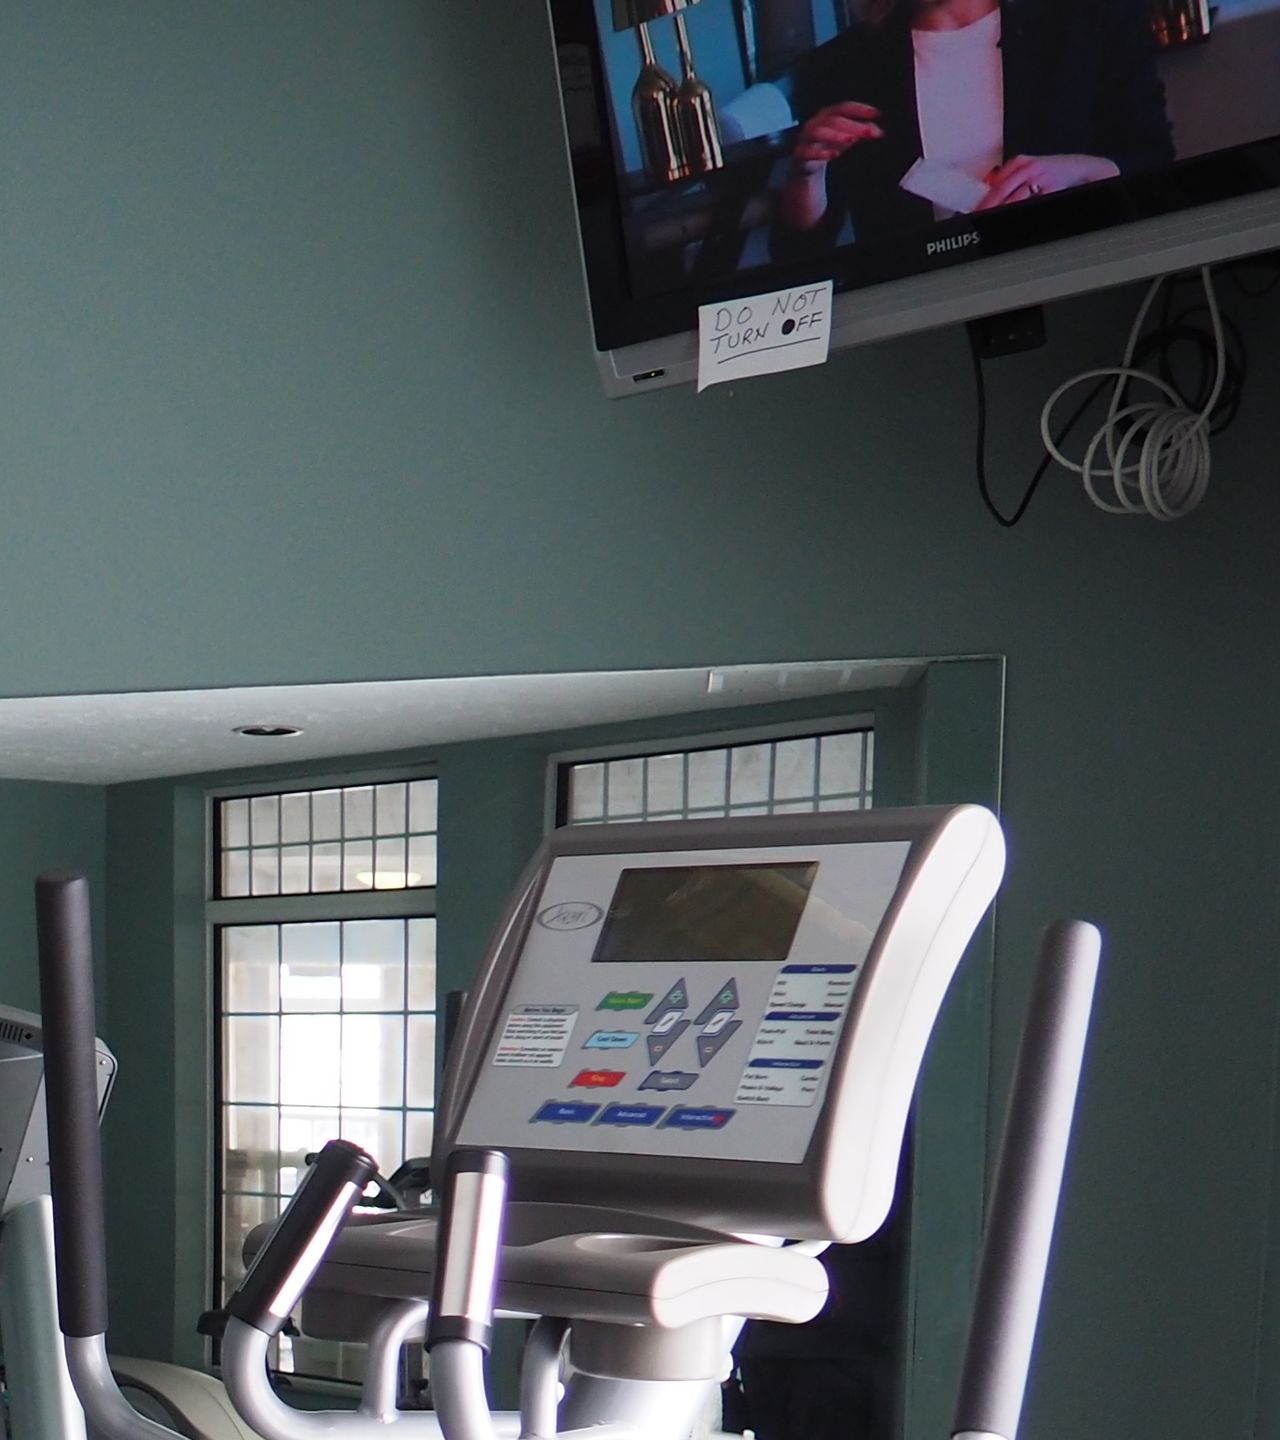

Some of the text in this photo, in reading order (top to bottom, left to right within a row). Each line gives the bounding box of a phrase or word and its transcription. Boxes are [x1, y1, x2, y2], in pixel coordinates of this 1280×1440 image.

[927, 231, 980, 255] PHILIPS
[714, 287, 827, 332] DO NOT
[709, 311, 823, 354] TURN OFF
